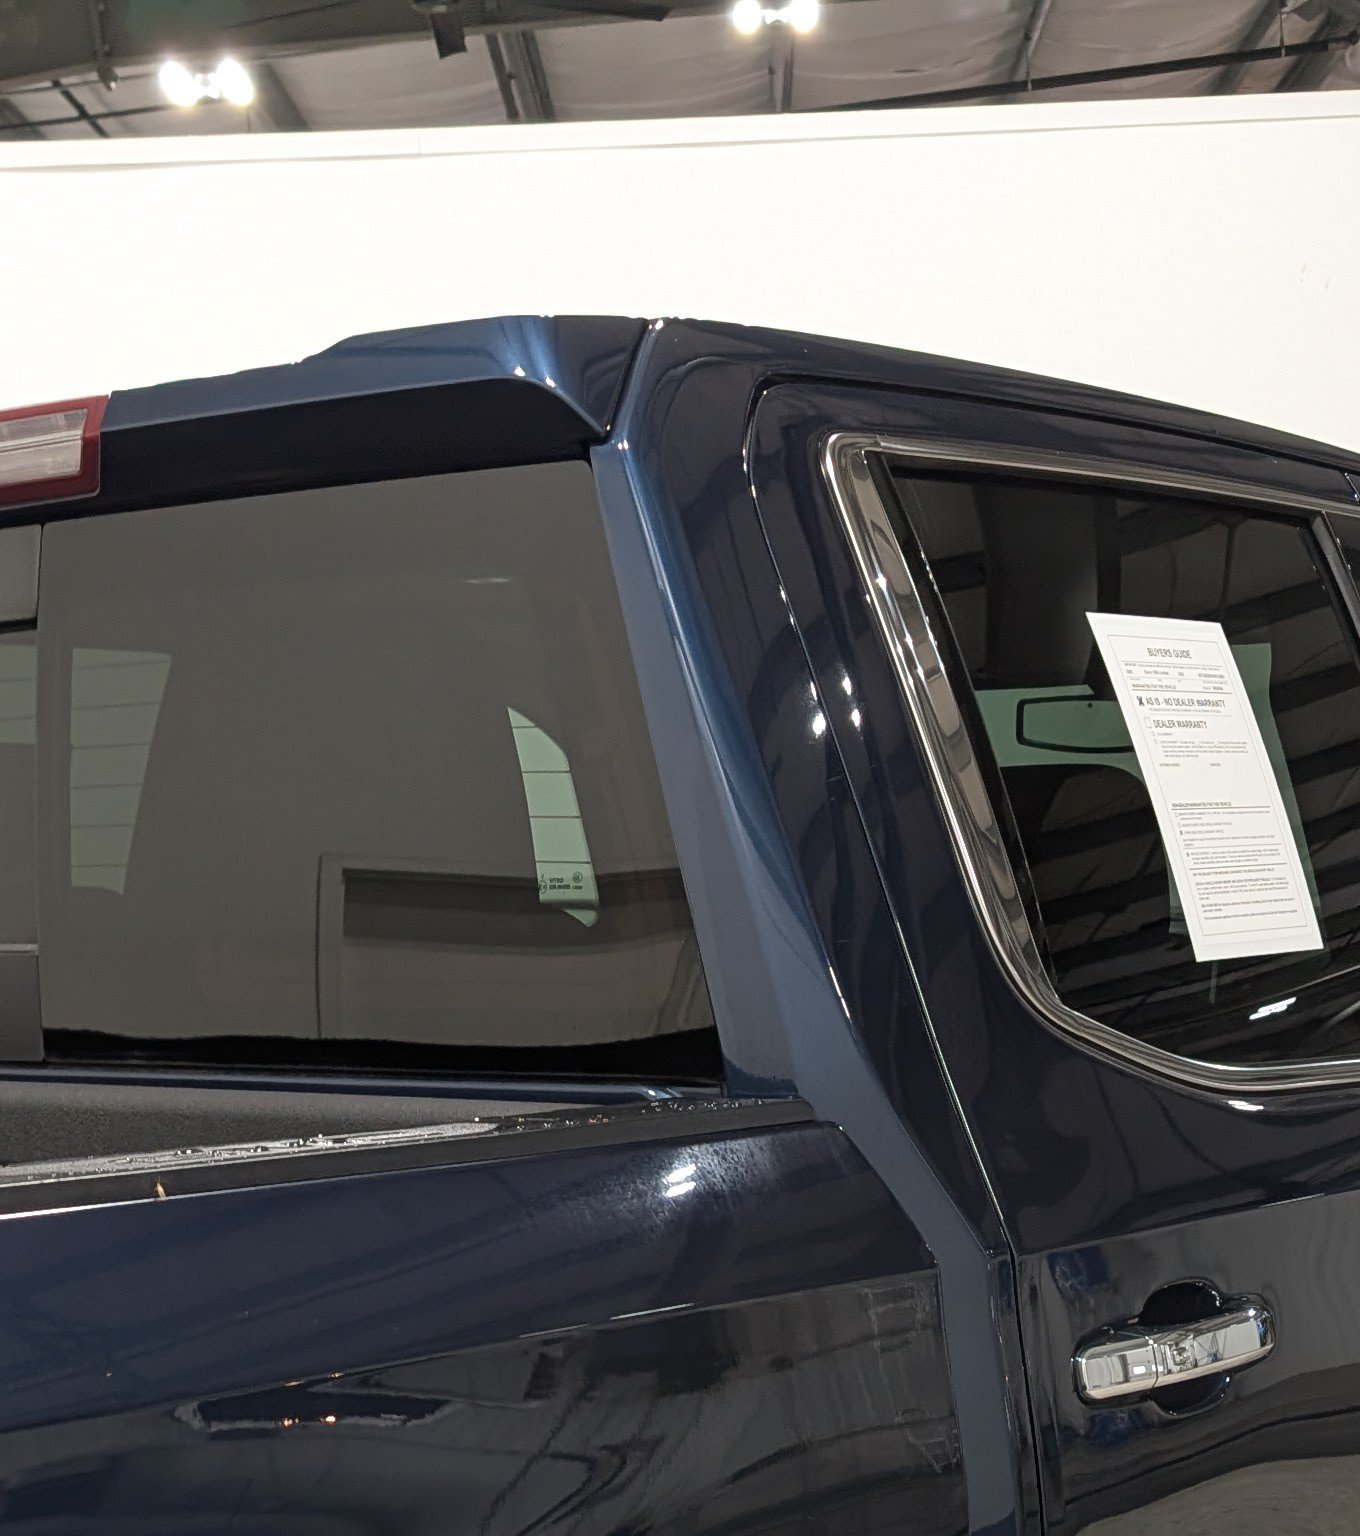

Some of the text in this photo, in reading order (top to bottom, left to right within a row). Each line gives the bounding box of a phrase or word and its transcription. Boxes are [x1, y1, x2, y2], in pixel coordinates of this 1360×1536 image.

[1147, 647, 1192, 659] BUYERS GUIDE
[1146, 697, 1154, 706] AS
[1173, 698, 1196, 707] DEALER
[1195, 698, 1226, 708] WARRANTY
[1153, 719, 1208, 729] DEALER WARRANTY
